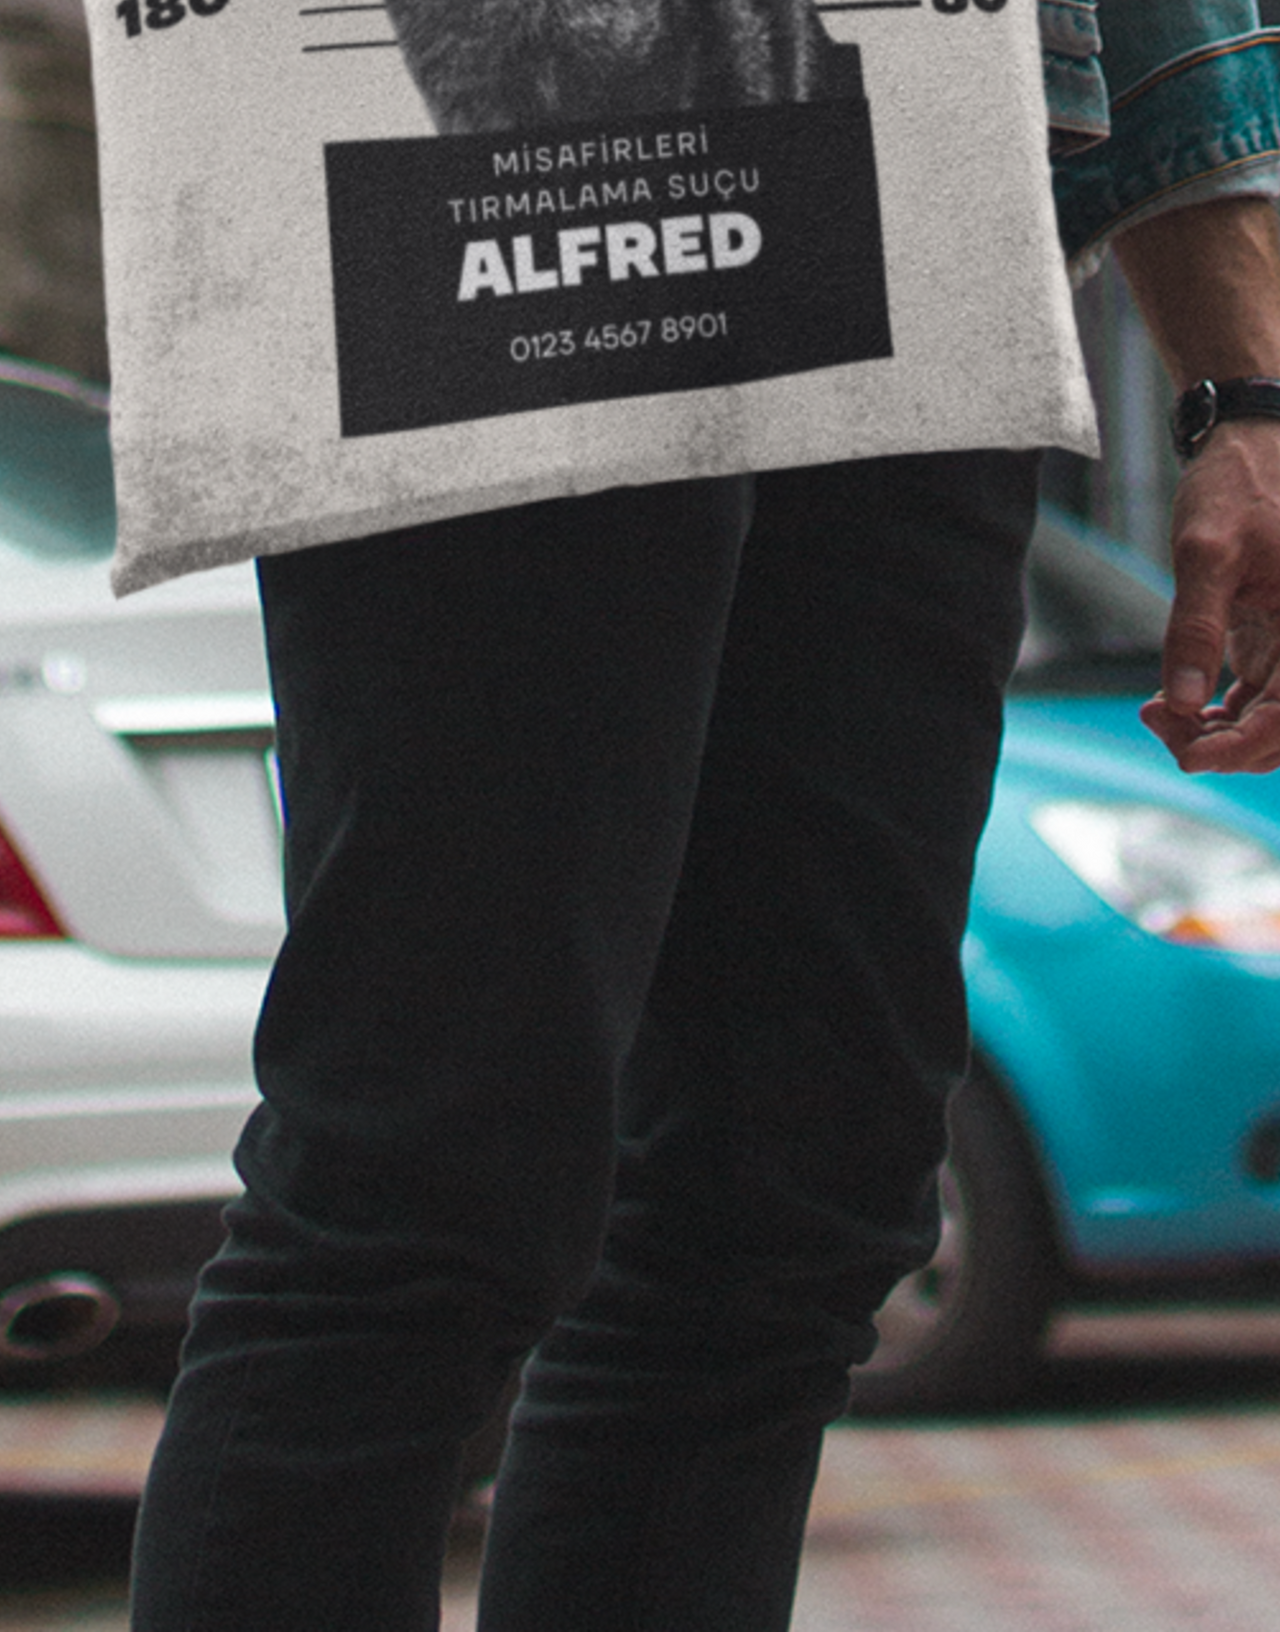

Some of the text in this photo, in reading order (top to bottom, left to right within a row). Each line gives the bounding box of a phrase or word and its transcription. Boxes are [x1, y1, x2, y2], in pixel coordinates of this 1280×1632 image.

[492, 124, 709, 177] MİSAFİRLERİ
[448, 168, 760, 224] TIRMALAMA SUÇU
[456, 211, 763, 303] ALFRED
[509, 312, 728, 363] 0123 4567 8901
